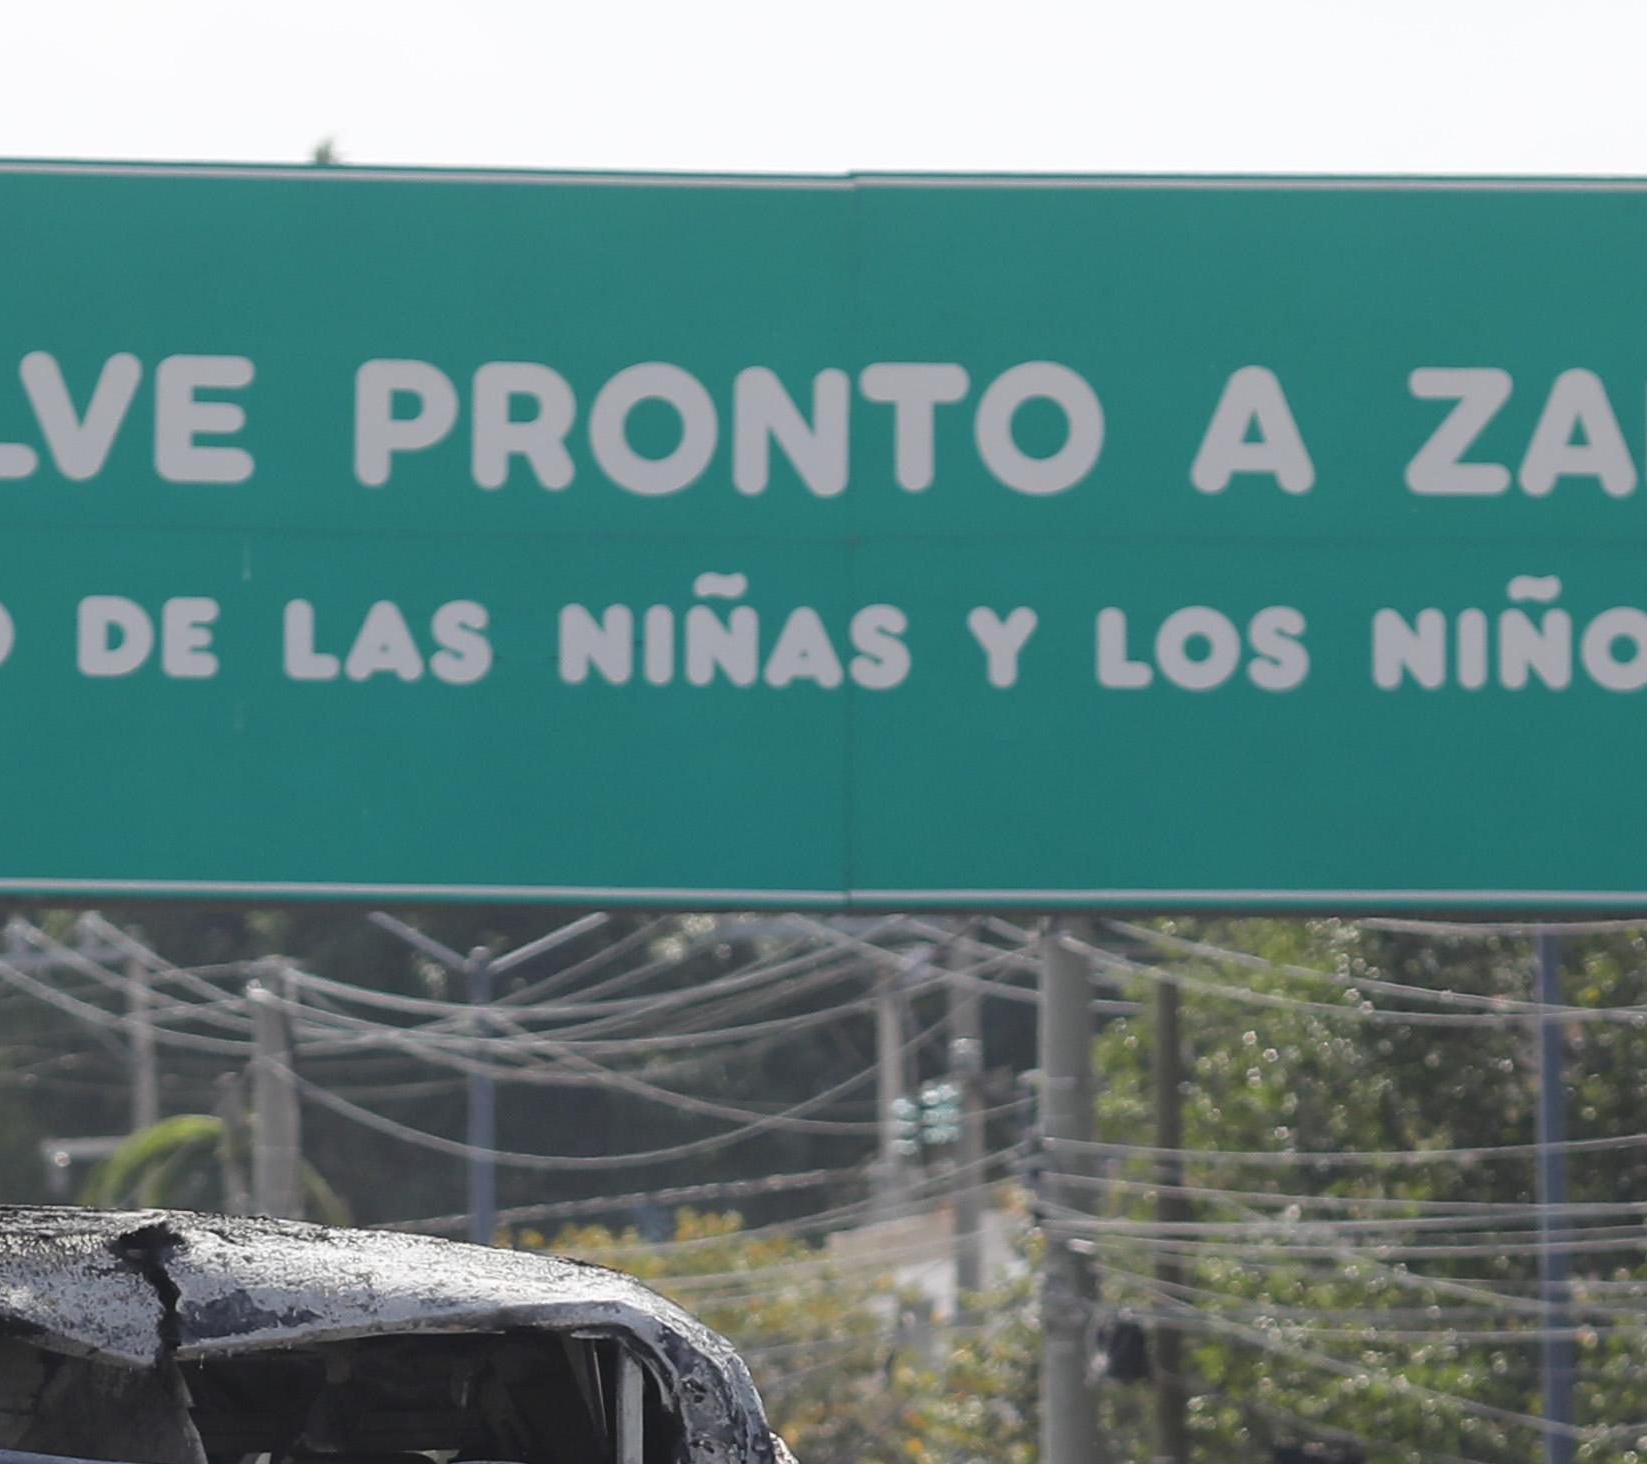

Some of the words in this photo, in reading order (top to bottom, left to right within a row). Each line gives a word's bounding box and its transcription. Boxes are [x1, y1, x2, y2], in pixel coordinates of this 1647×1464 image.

[354, 359, 1105, 498] PRONTO
[1190, 365, 1316, 495] A
[77, 595, 220, 679] DE
[283, 599, 493, 685] LAS
[558, 571, 911, 690] NIÑAS
[967, 606, 1038, 689] Y
[1096, 605, 1310, 692] LOS
